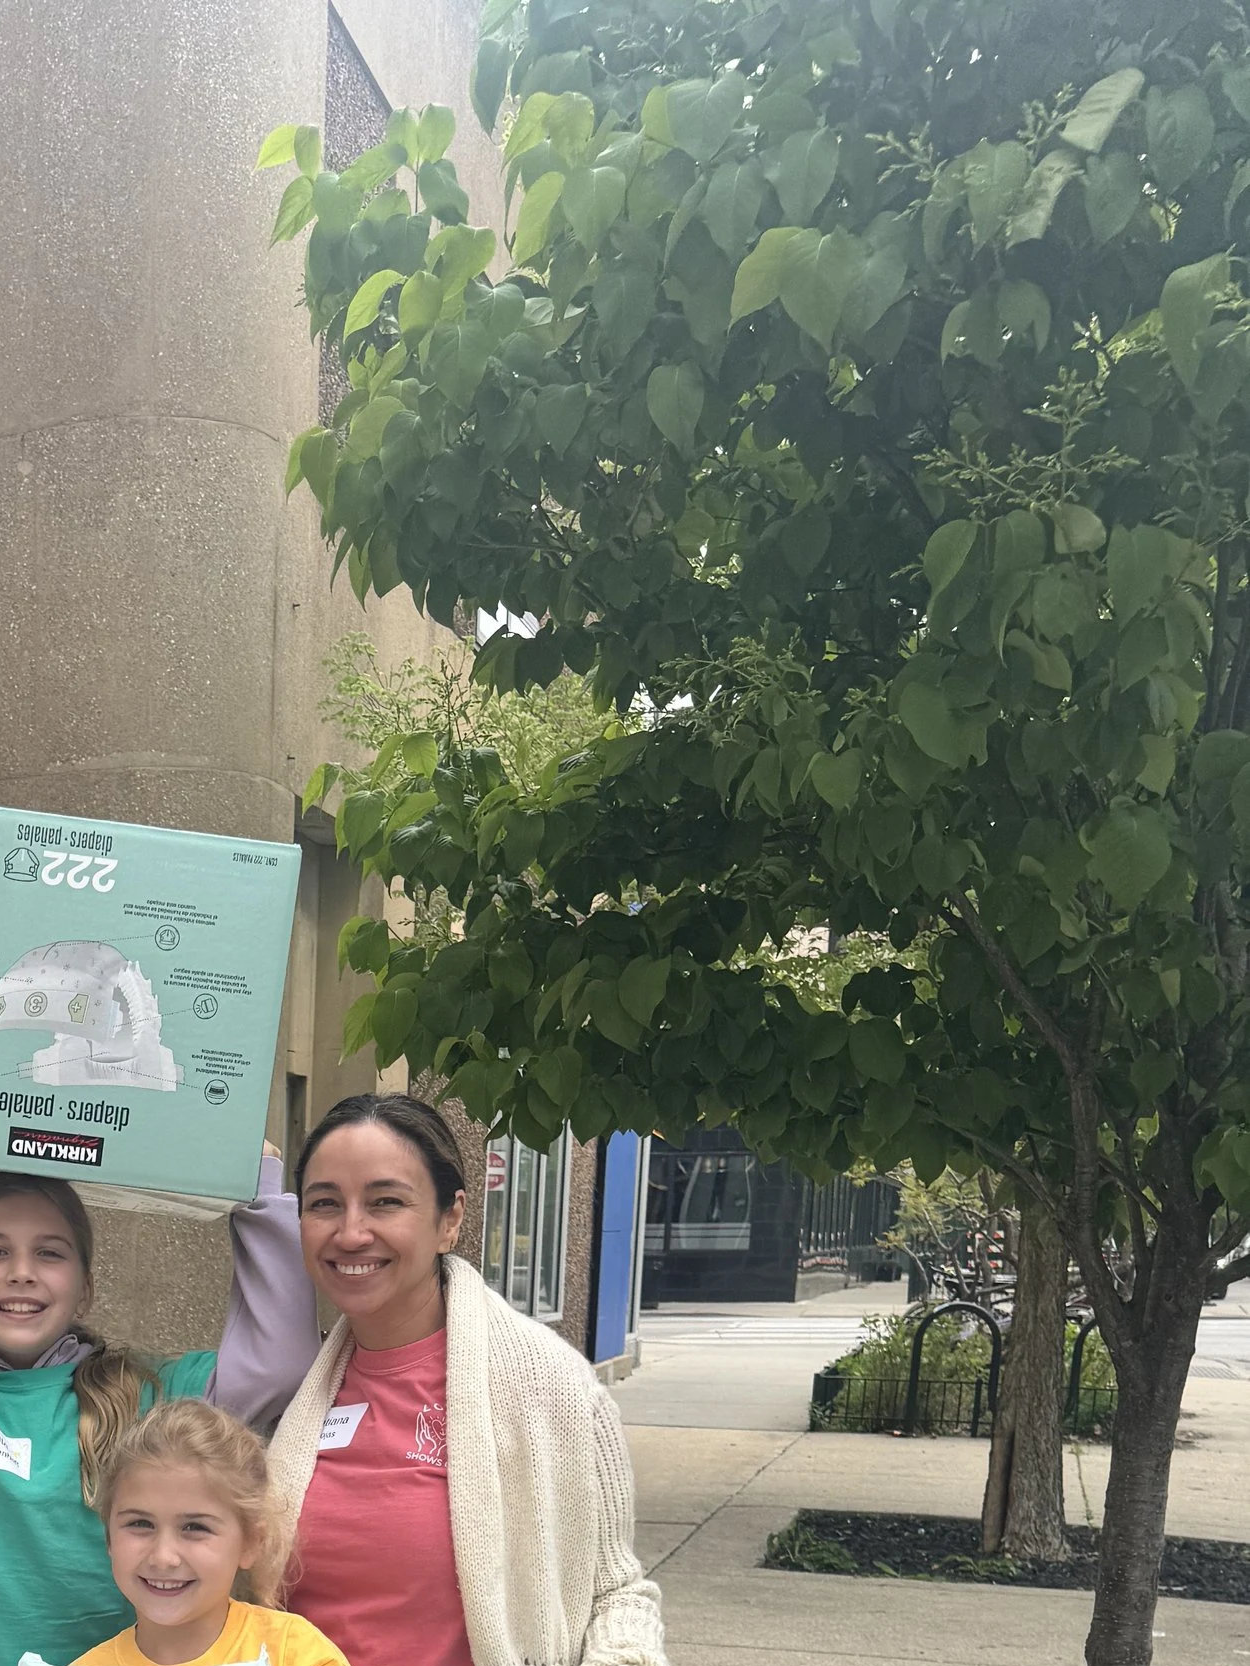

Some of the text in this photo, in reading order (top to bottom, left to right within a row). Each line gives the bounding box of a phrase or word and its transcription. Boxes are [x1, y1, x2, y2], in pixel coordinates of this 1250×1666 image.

[17, 823, 113, 856] diapers pañales
[41, 850, 119, 893] 222
[28, 996, 41, 1015] 3
[67, 1100, 130, 1132] diapers
[11, 1139, 97, 1163] KIRKLAND
[405, 1451, 443, 1467] SHOWS
